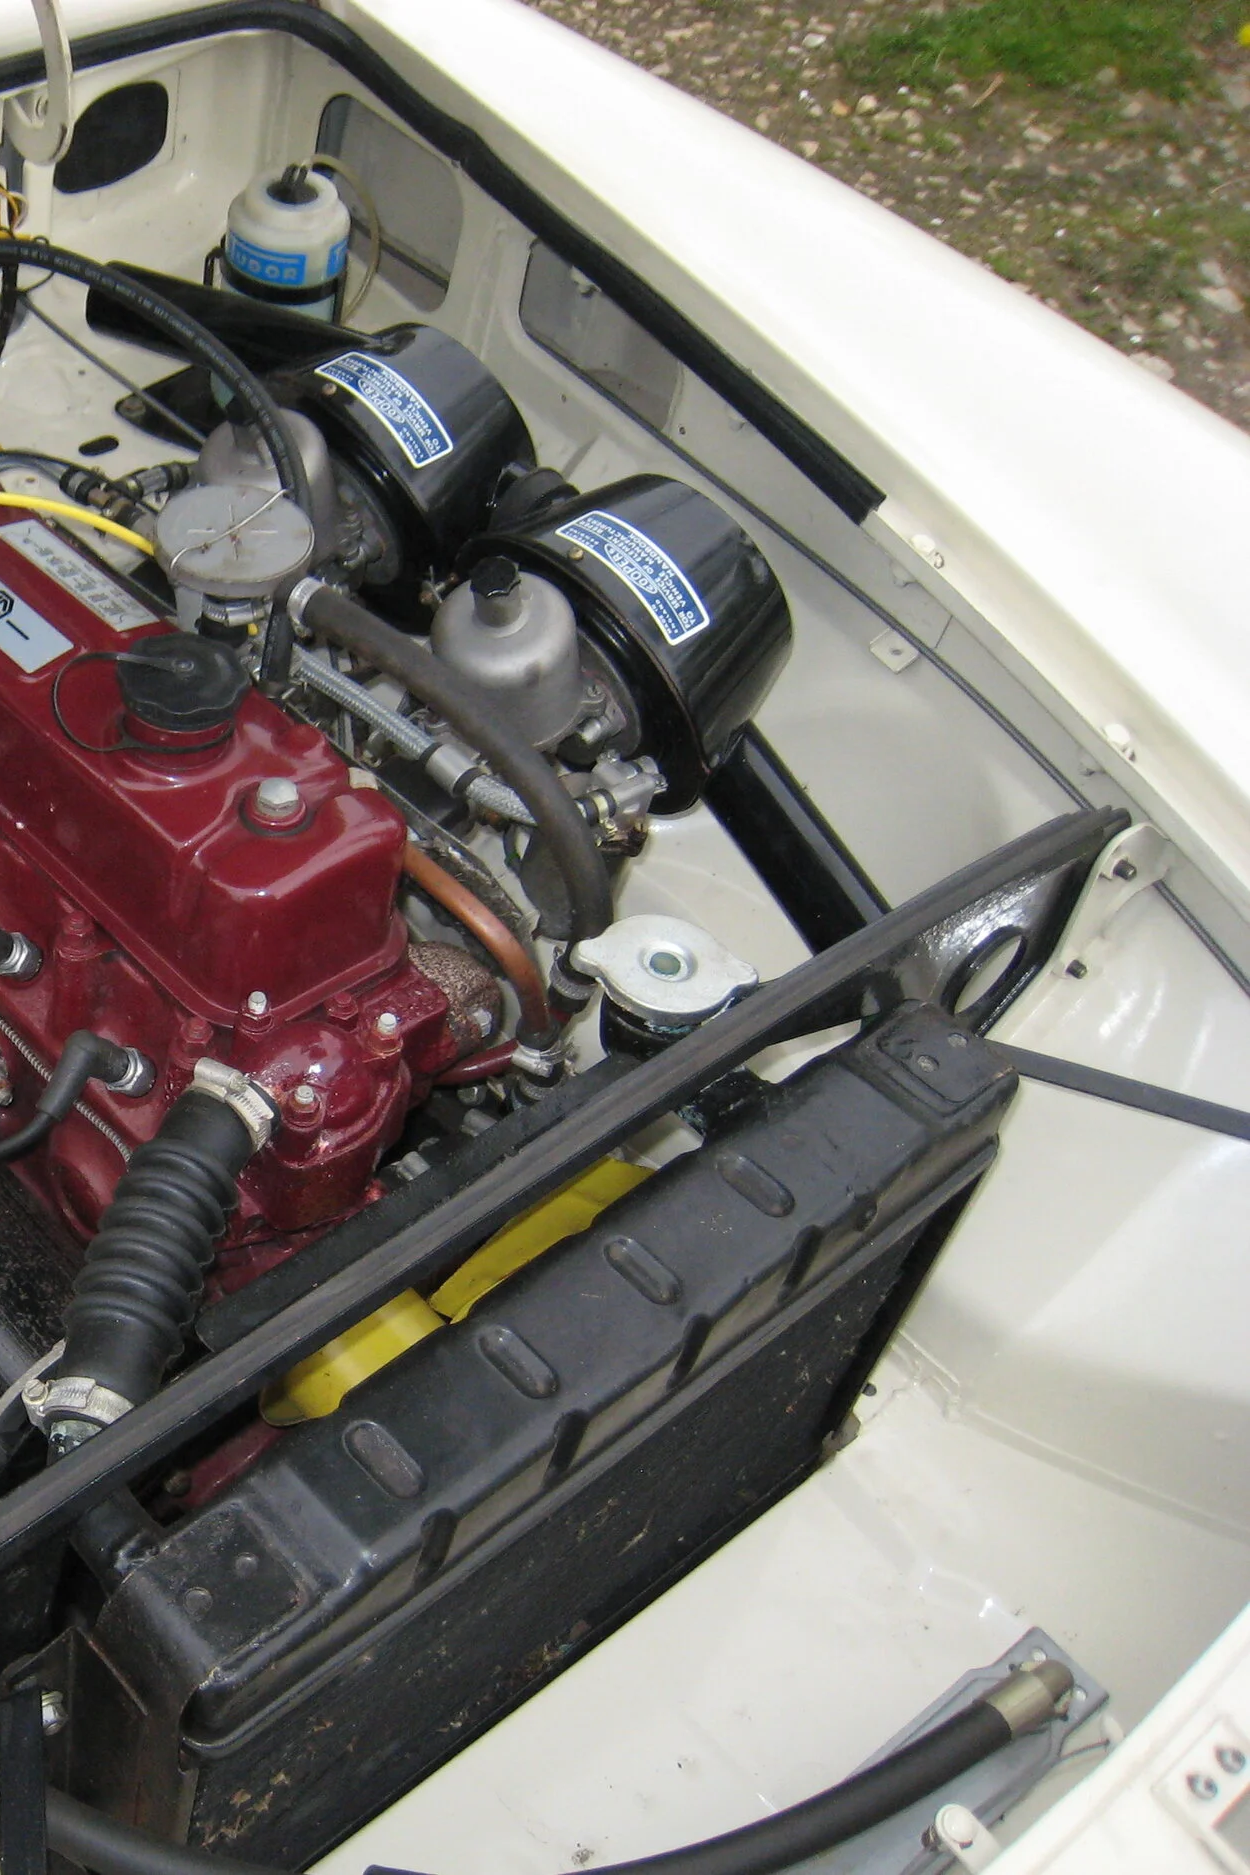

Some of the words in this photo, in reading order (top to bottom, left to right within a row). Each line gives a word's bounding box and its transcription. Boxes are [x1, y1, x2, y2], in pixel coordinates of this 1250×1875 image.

[231, 240, 298, 279] TUDOR
[361, 381, 402, 421] COOPERS
[391, 395, 402, 406] OF
[402, 407, 425, 436] SERVICE
[407, 402, 432, 434] VEHICLE
[423, 437, 436, 454] FOR
[431, 437, 440, 450] TO
[579, 518, 603, 533] REFER
[586, 516, 654, 565] MANUFACTURERS
[608, 534, 641, 562] ELEMENT
[607, 546, 654, 591] COOPERS
[642, 563, 654, 575] OF
[654, 576, 680, 609] SERVICE
[658, 570, 687, 606] VEHICLE
[654, 598, 679, 633] ENGLAND
[658, 614, 672, 634] MADE
[678, 610, 692, 628] FOR
[685, 610, 697, 624] TO
